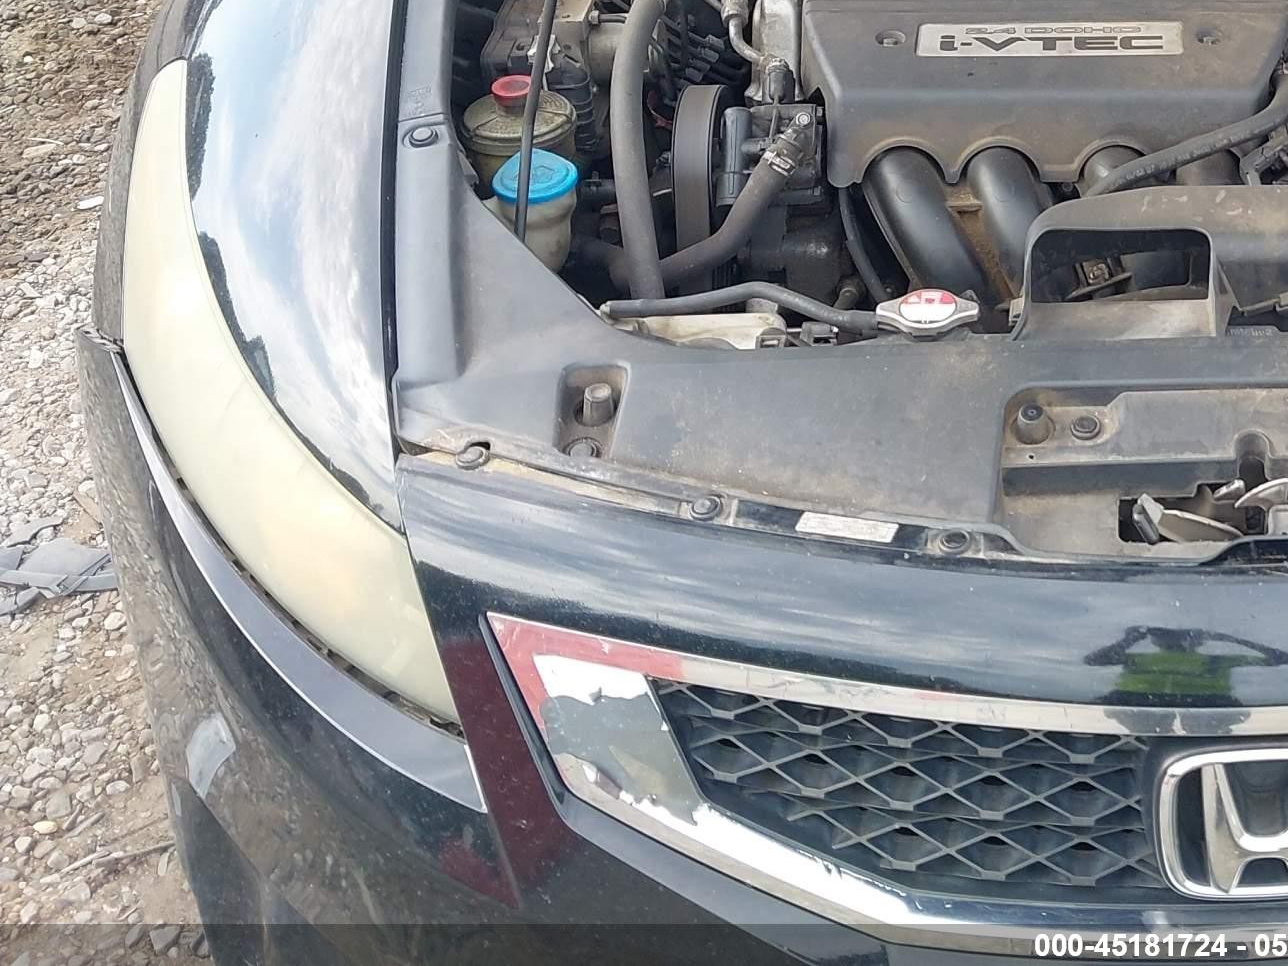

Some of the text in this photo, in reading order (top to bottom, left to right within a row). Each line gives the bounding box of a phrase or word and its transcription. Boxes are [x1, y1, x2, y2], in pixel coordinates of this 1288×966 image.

[965, 26, 1141, 35] 2.4 DOHC
[940, 35, 1163, 52] i-VTEC
